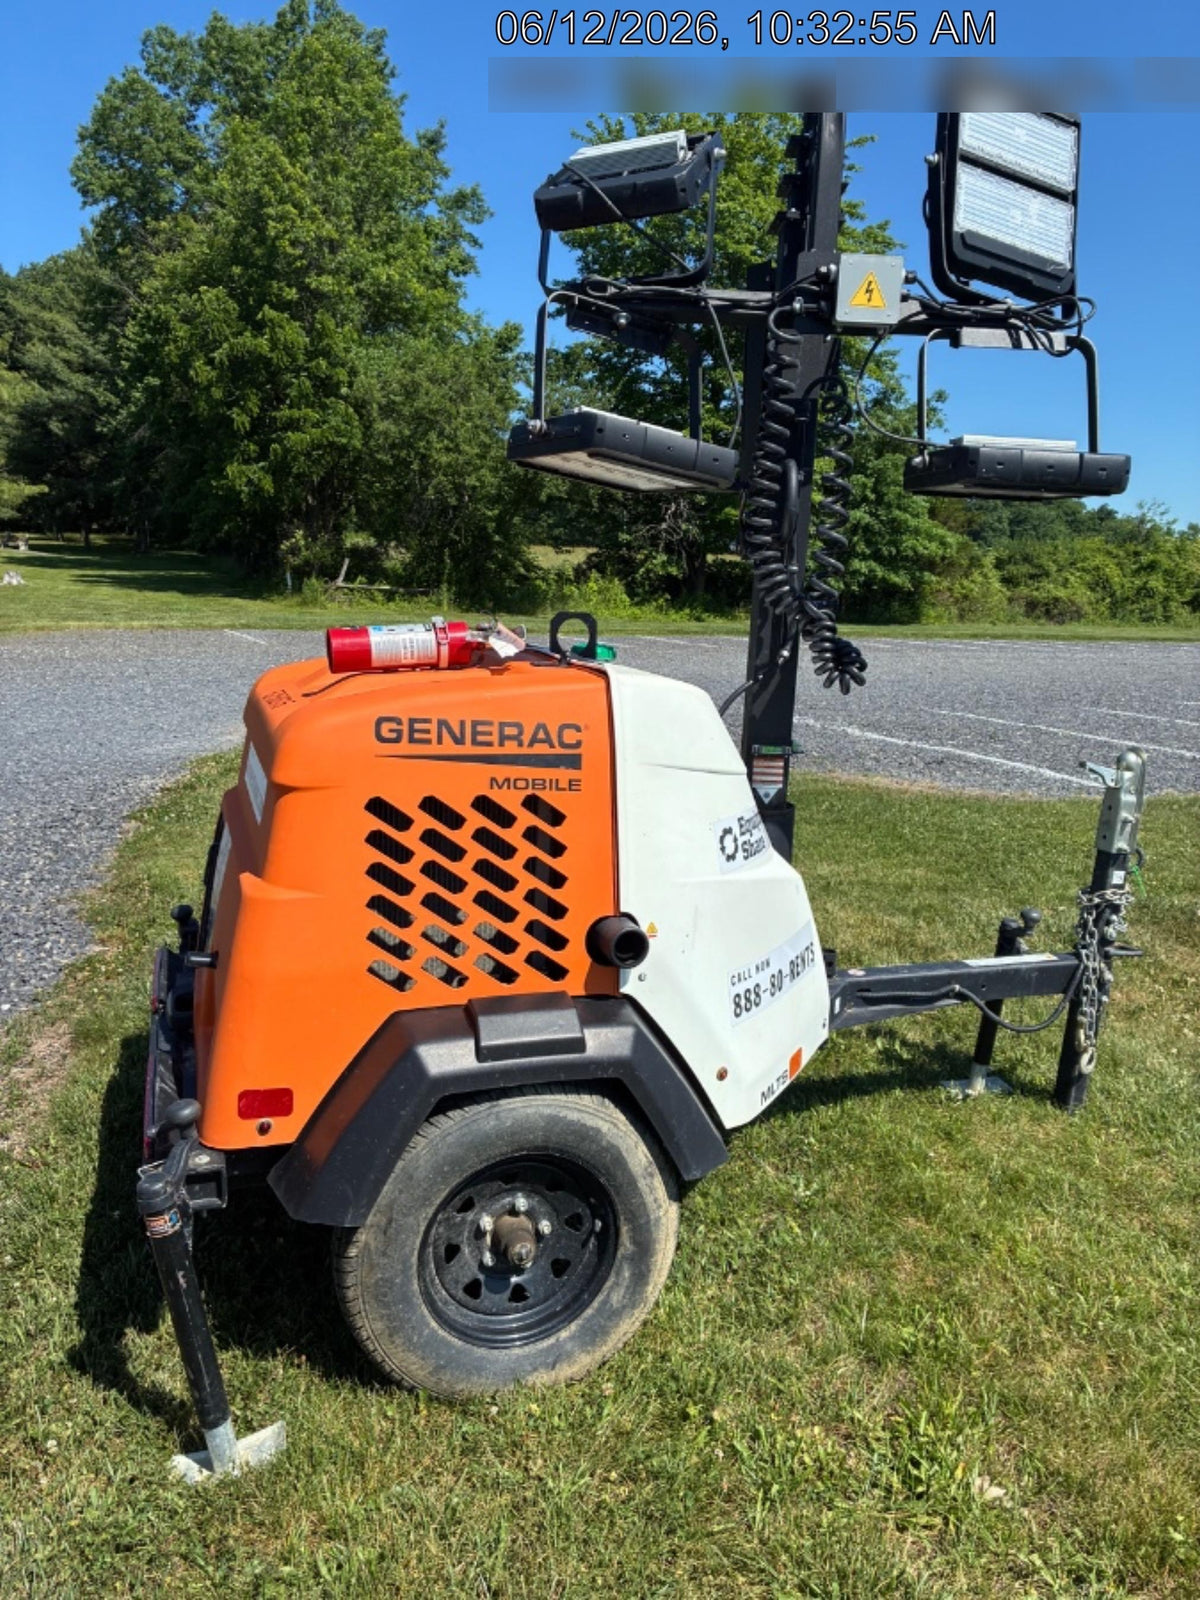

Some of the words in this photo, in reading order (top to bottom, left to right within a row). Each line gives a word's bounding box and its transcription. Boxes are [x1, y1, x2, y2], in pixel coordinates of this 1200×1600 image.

[374, 715, 583, 750] GENERAC
[489, 776, 582, 792] MOBILE
[731, 968, 752, 987] CALL
[755, 957, 770, 975] NOW
[733, 941, 815, 1019] 888-80-RENTS
